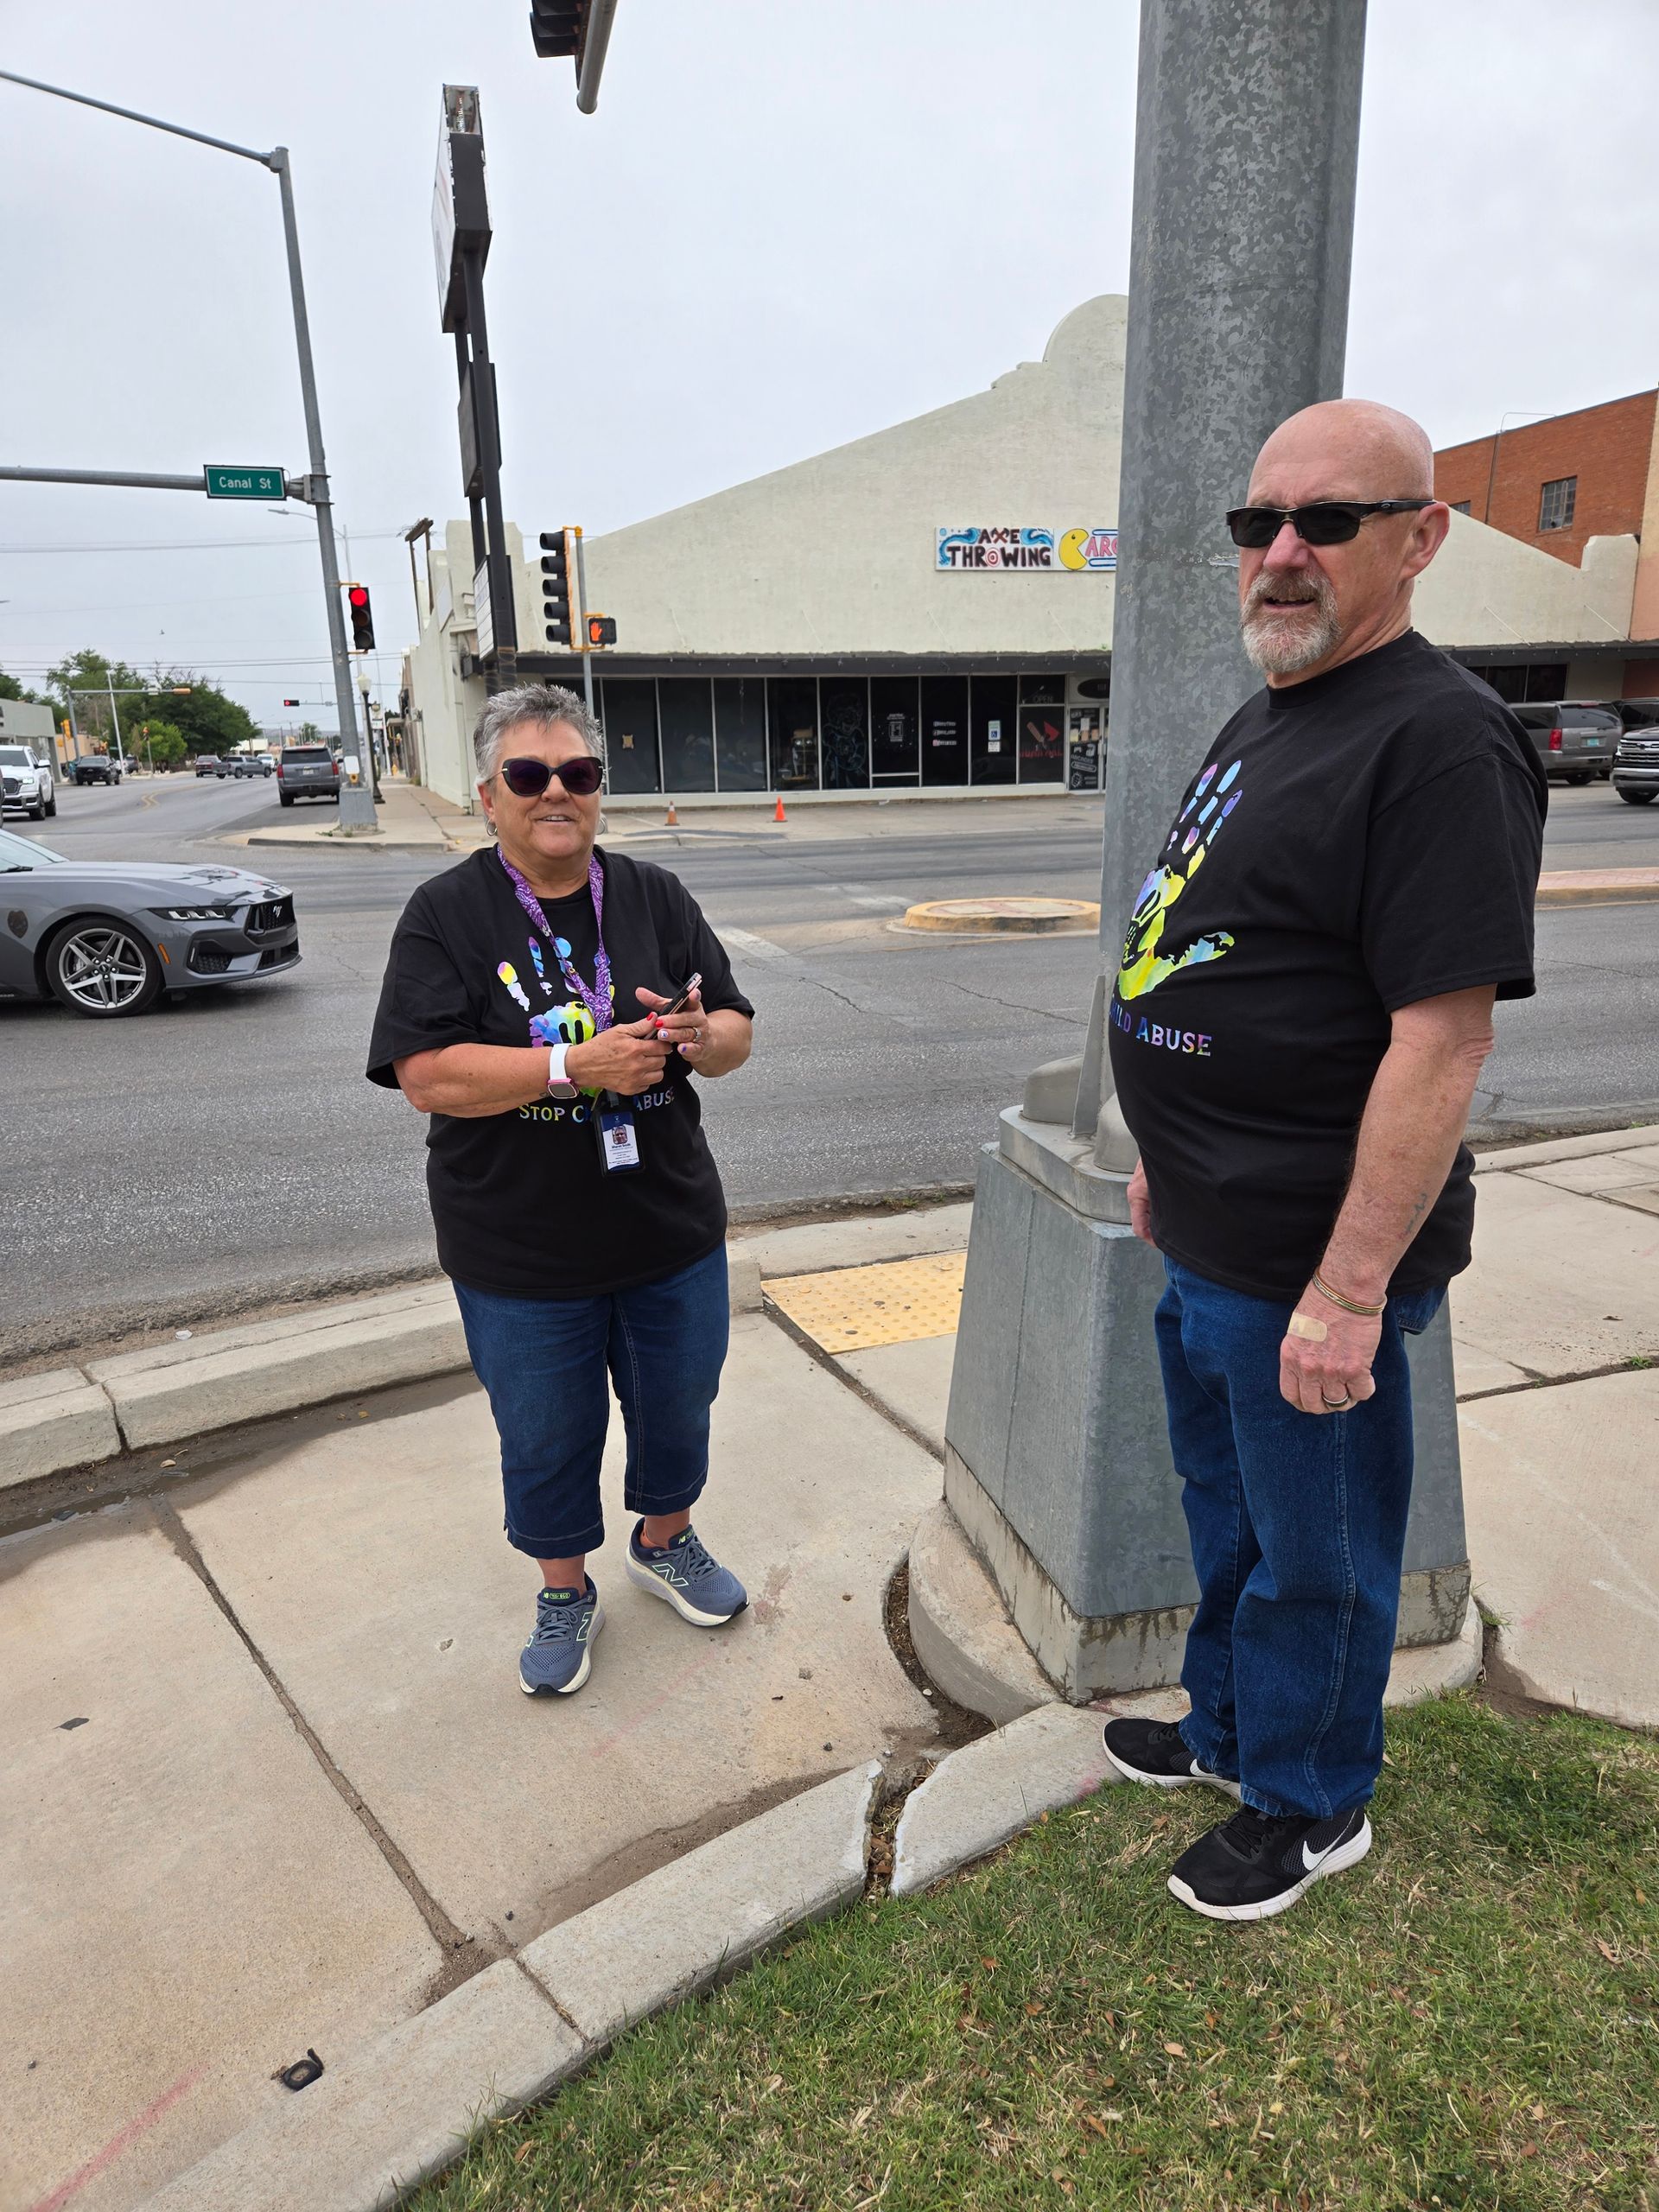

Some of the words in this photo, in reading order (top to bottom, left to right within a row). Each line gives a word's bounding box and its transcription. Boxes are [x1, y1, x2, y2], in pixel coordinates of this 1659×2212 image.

[219, 476, 252, 489] Canal
[259, 477, 272, 490] St
[978, 528, 1020, 544] AXE
[947, 545, 1052, 567] THROWING
[1136, 1016, 1212, 1057] ABUSE
[519, 1103, 565, 1122] STOP
